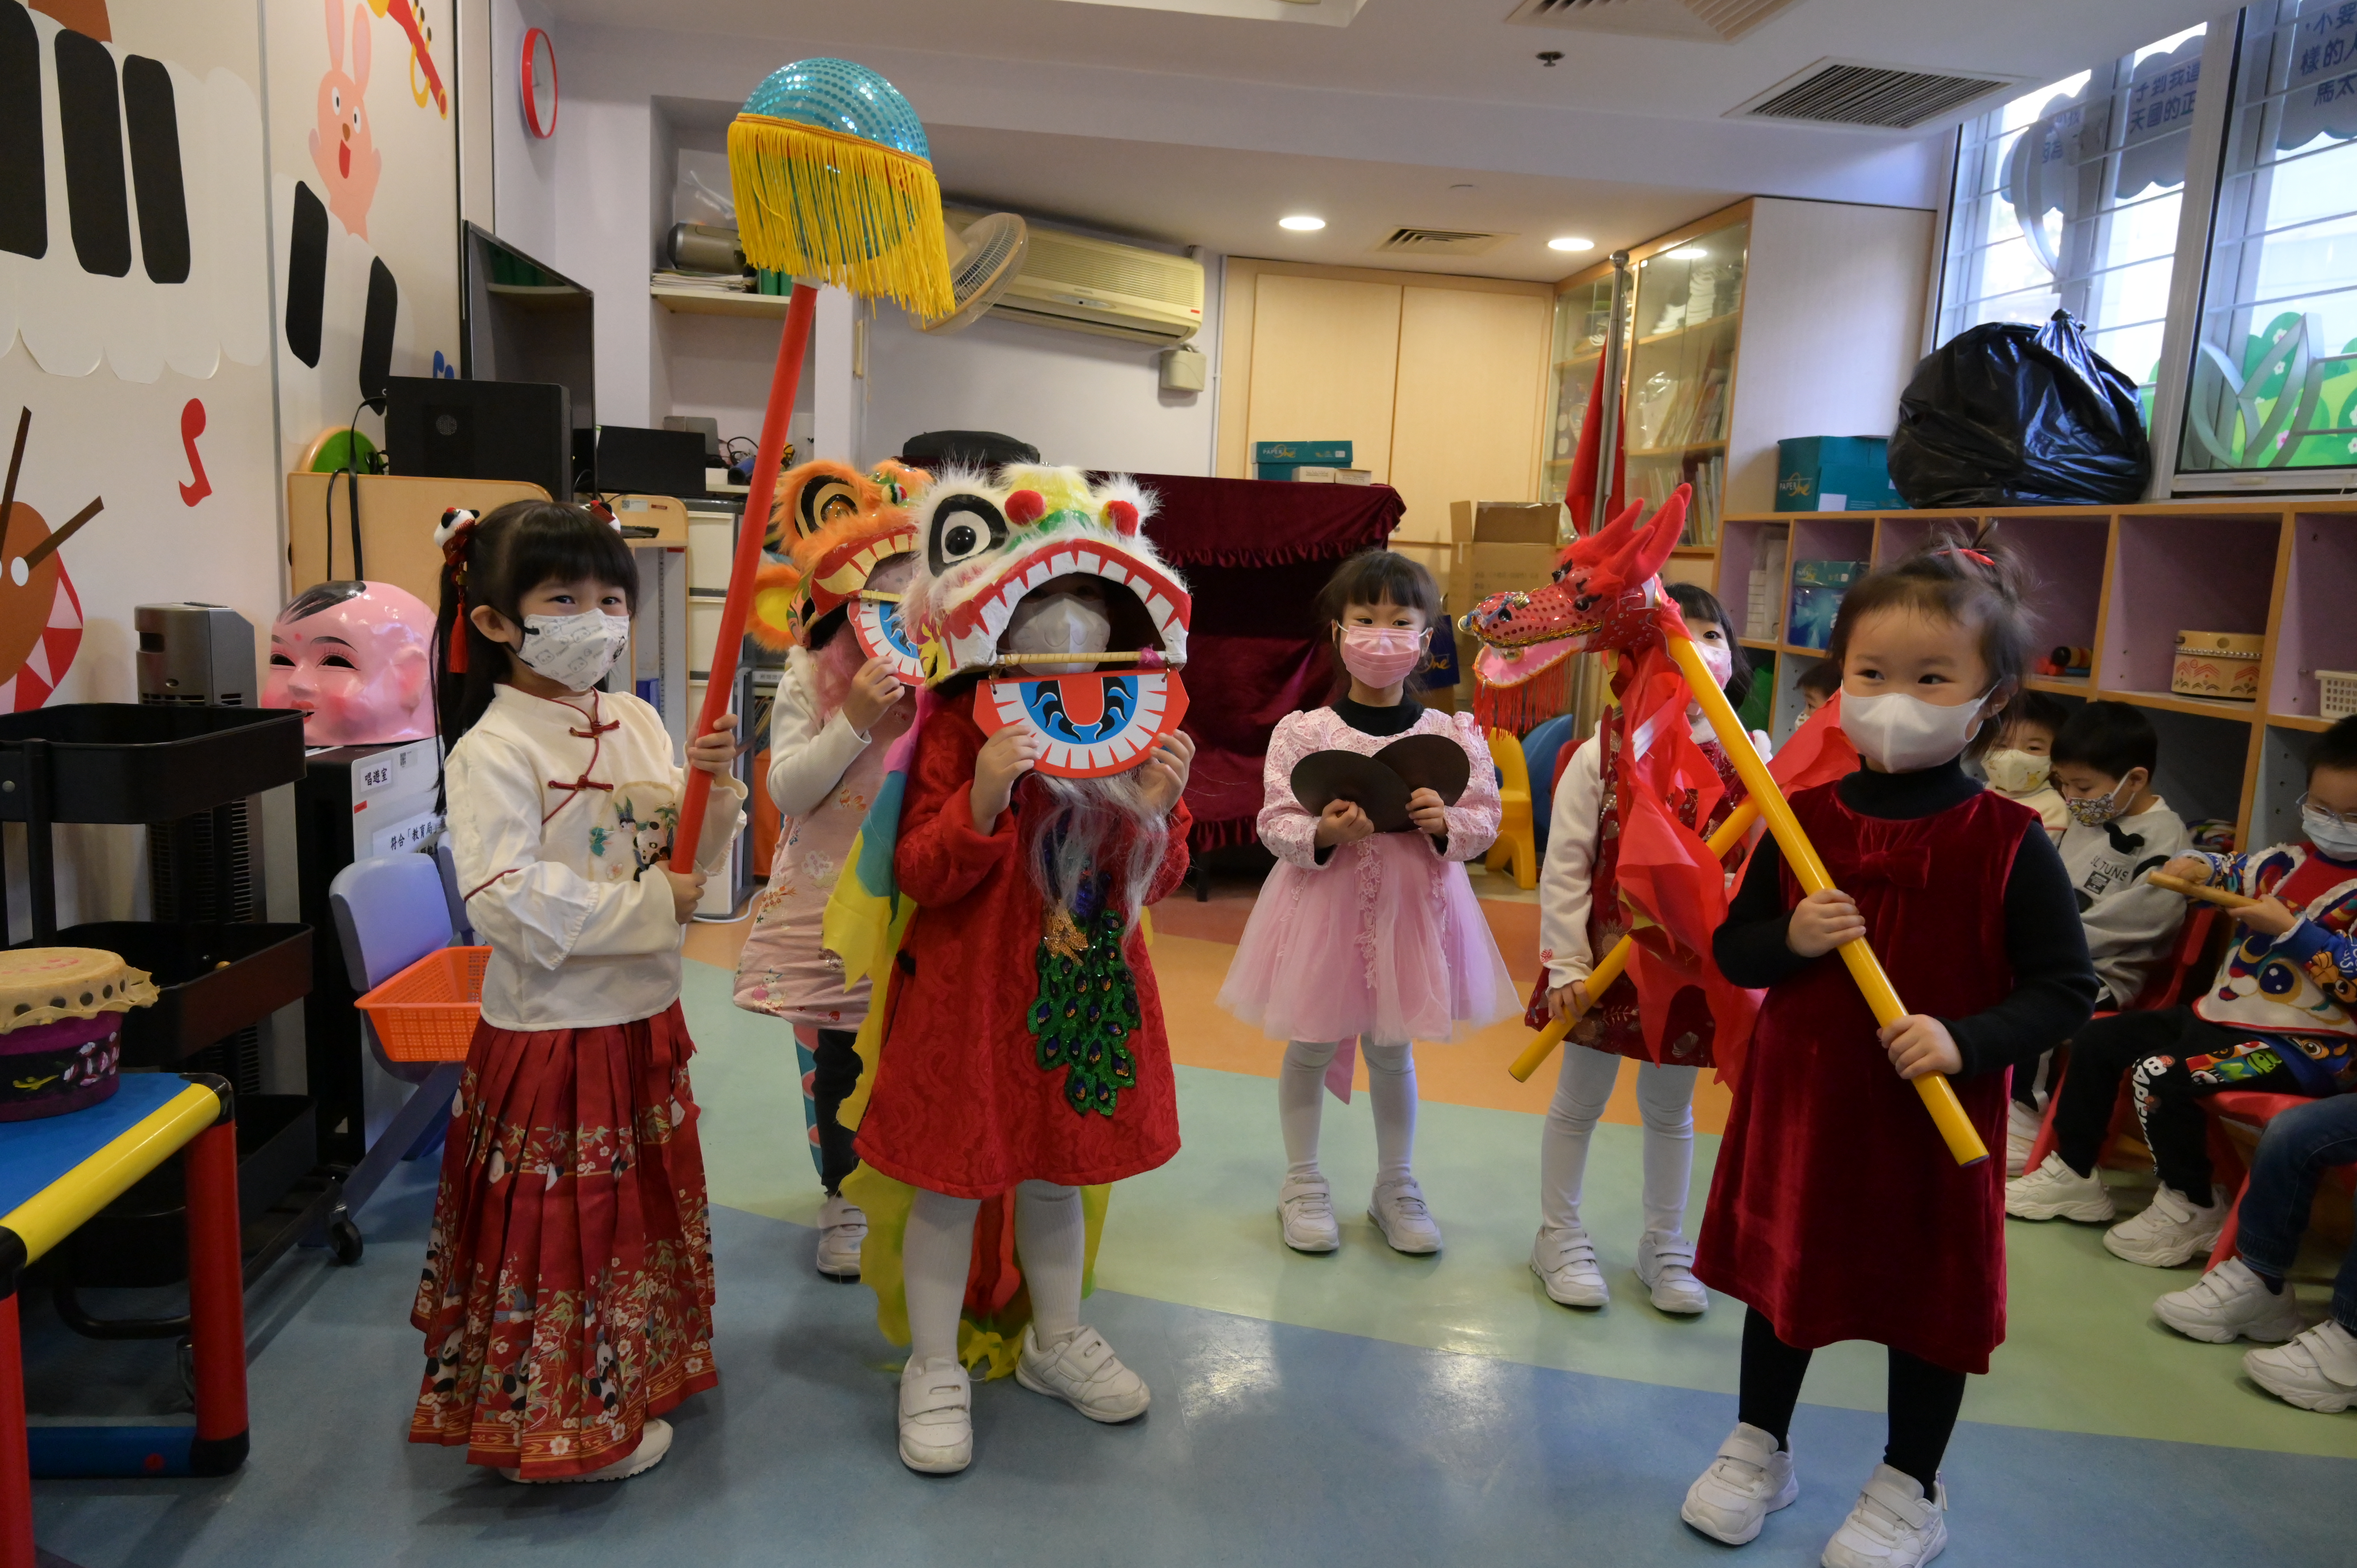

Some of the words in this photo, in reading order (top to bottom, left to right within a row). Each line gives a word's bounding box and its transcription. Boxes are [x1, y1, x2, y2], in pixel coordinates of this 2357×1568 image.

[1779, 481, 1796, 491] PAPER
[365, 768, 387, 786] 唱遊室
